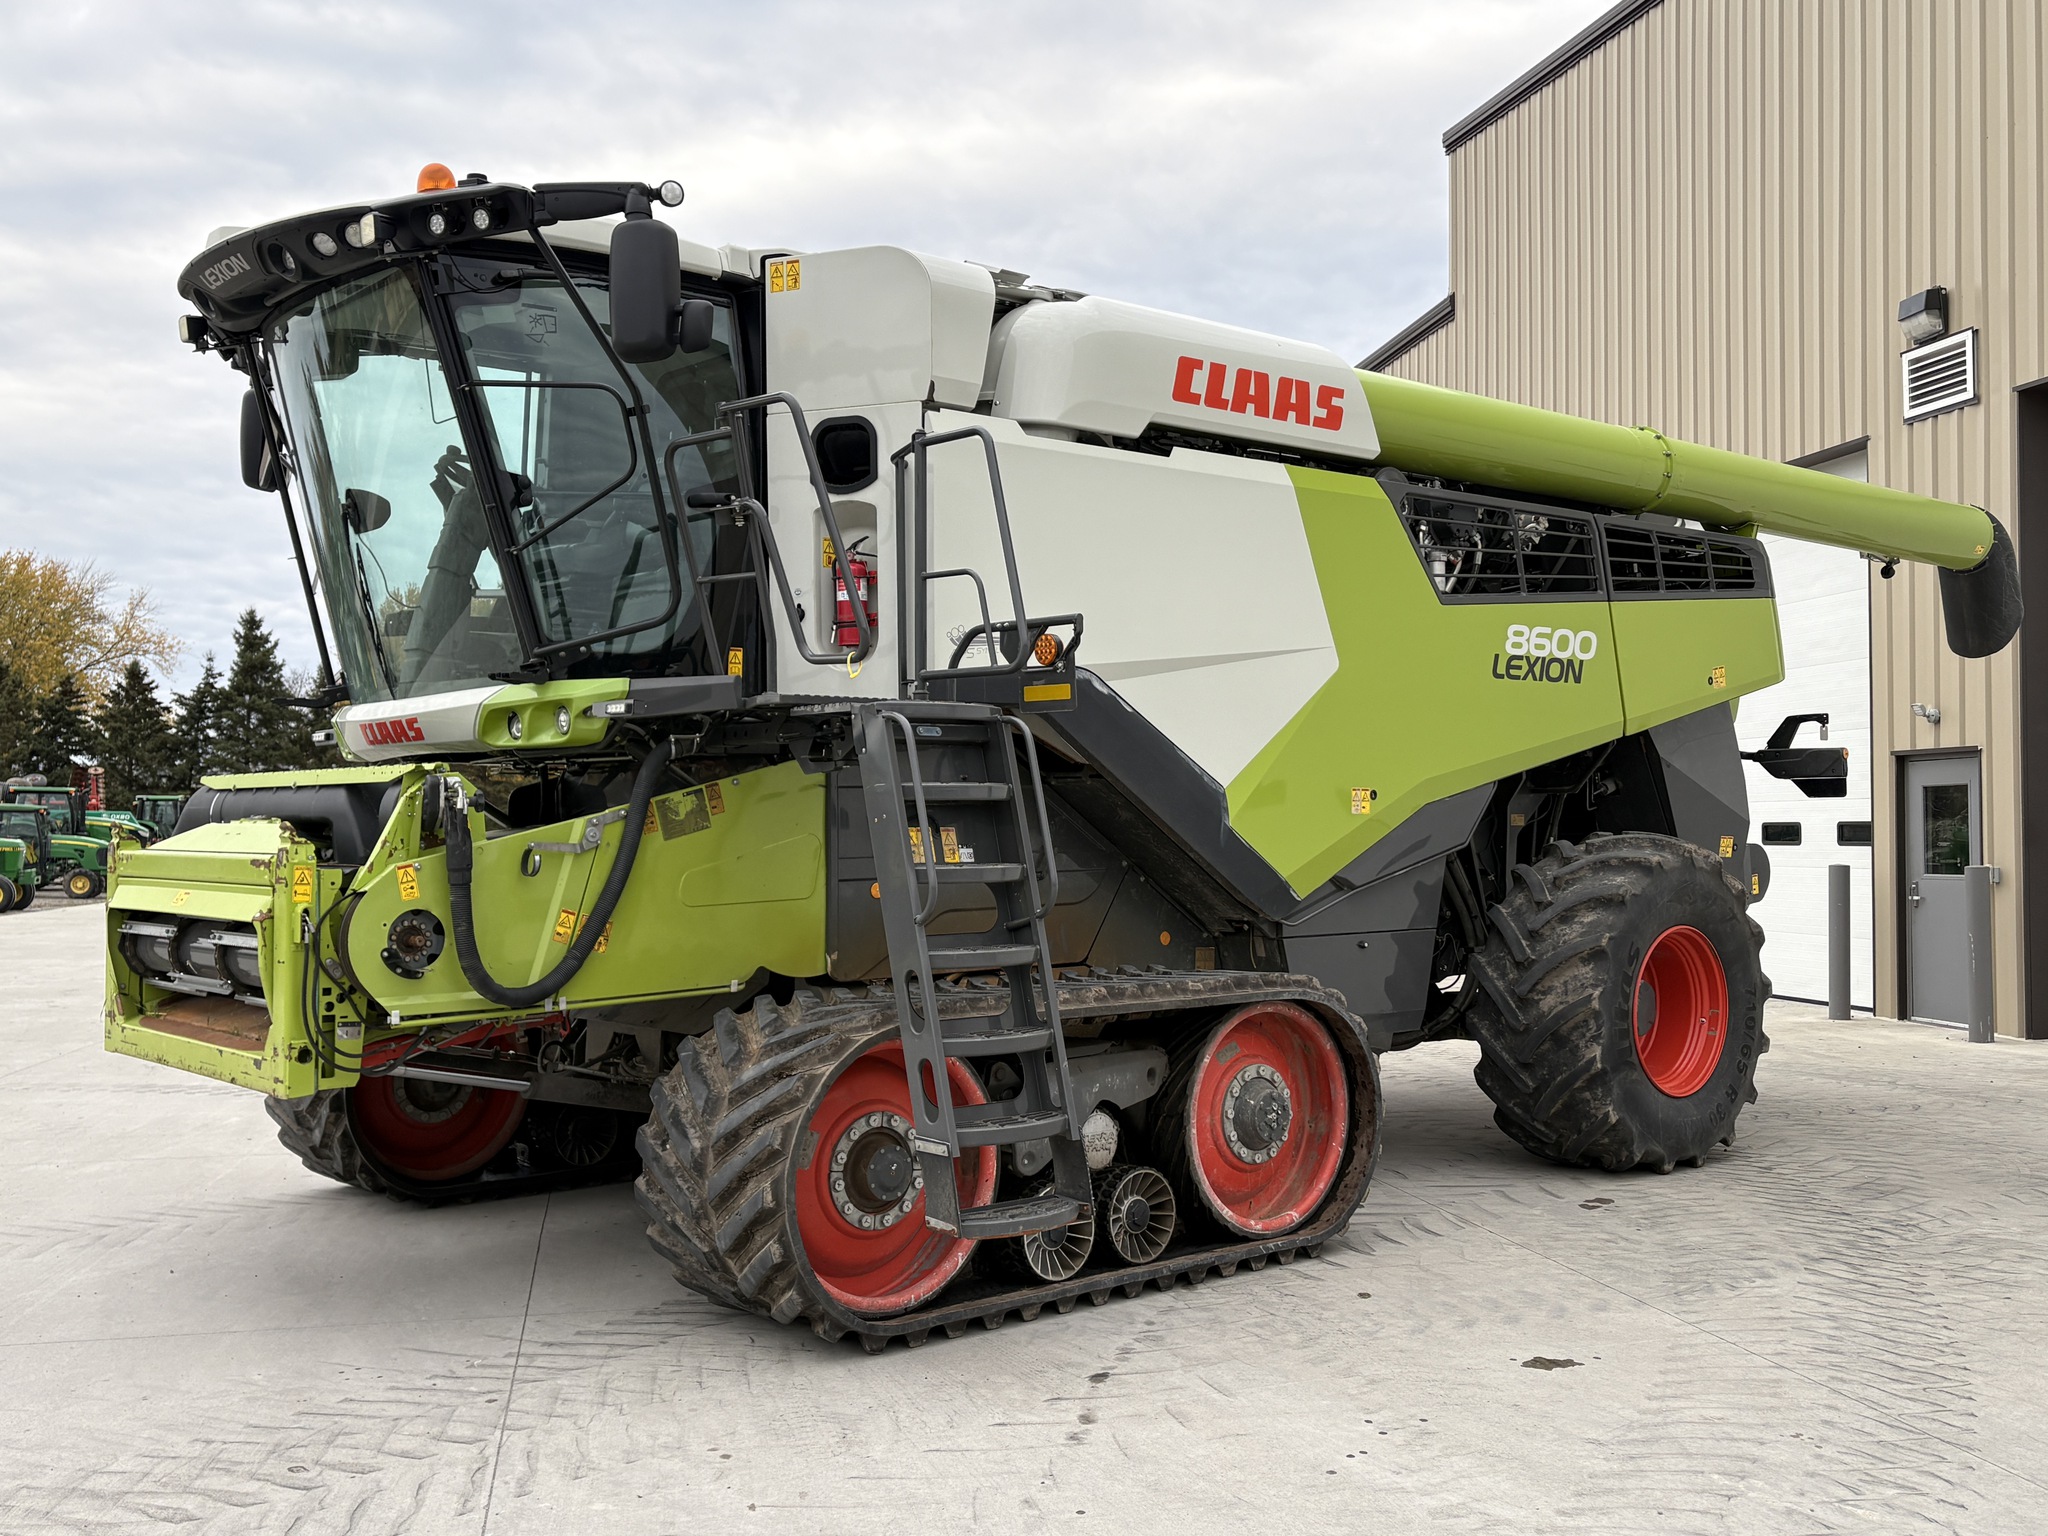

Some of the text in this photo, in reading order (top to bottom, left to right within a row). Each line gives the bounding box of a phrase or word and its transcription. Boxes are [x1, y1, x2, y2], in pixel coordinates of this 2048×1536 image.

[199, 252, 251, 290] LEXION
[1172, 355, 1345, 431] CLAAS
[1505, 624, 1597, 660] 8600
[1492, 653, 1584, 684] LEXION
[359, 716, 426, 746] CLAAS
[1725, 1083, 1739, 1104] R
